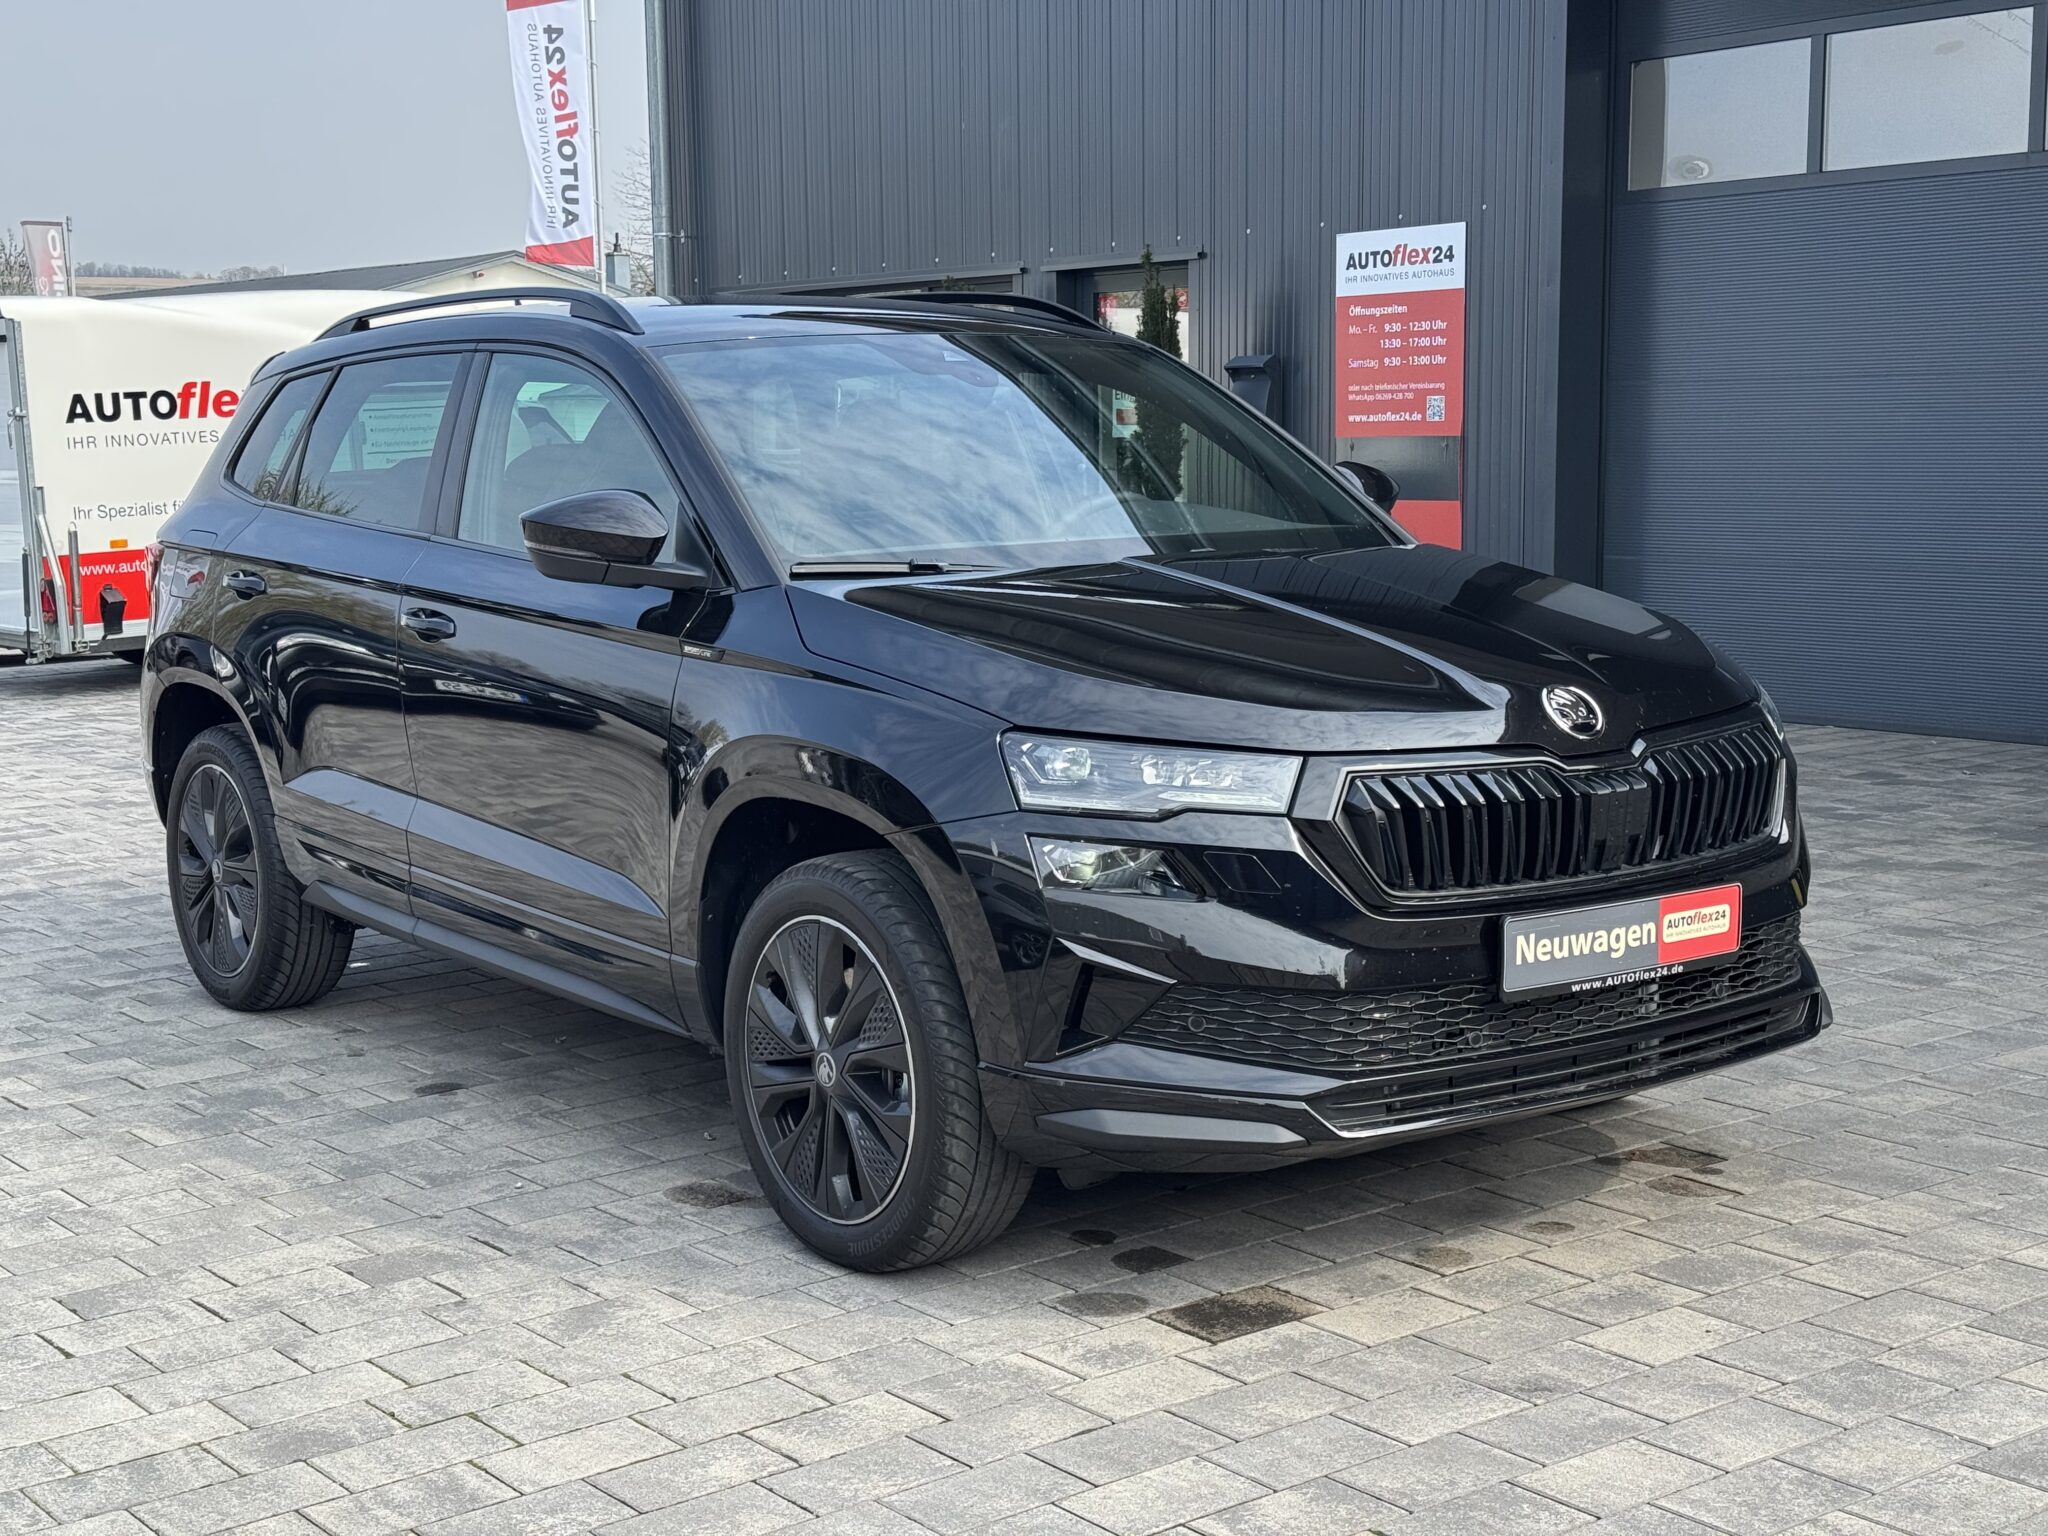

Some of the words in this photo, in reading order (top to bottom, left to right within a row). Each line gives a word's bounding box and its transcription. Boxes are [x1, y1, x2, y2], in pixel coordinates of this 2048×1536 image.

[1345, 243, 1455, 271] AUTOflex24
[1345, 275, 1358, 284] IHR
[1360, 271, 1410, 283] INNOVATIVES
[1411, 268, 1455, 279] AUTOHAUS
[1348, 304, 1408, 317] Öffnungszeiten
[1348, 325, 1362, 335] Mo.
[1368, 324, 1378, 334] Fr.
[1384, 322, 1401, 333] 9:30
[1408, 321, 1431, 331] 12:30
[1432, 319, 1448, 330] Uhr
[1380, 338, 1401, 349] 13:30
[1408, 337, 1430, 347] 17:00
[1431, 336, 1447, 346] Uhr
[1348, 358, 1379, 369] Samstag
[1384, 356, 1401, 367] 9:30
[1408, 355, 1430, 366] 13:00
[1431, 354, 1447, 365] Uhr
[1361, 383, 1374, 391] nach
[66, 381, 240, 424] AUTOfle
[1348, 393, 1374, 402] WhatsApp
[1348, 411, 1422, 422] www.autoflex24.de
[66, 436, 98, 450] IHR
[105, 430, 220, 448] INNOVATIVES
[73, 506, 93, 520] Ihr
[97, 501, 169, 522] Spezialist
[80, 561, 147, 577] www.auto
[1666, 910, 1727, 930] AUTOflex24
[1515, 921, 1656, 965] Neuwagen
[1571, 964, 1684, 992] www.AUTOflex24.de
